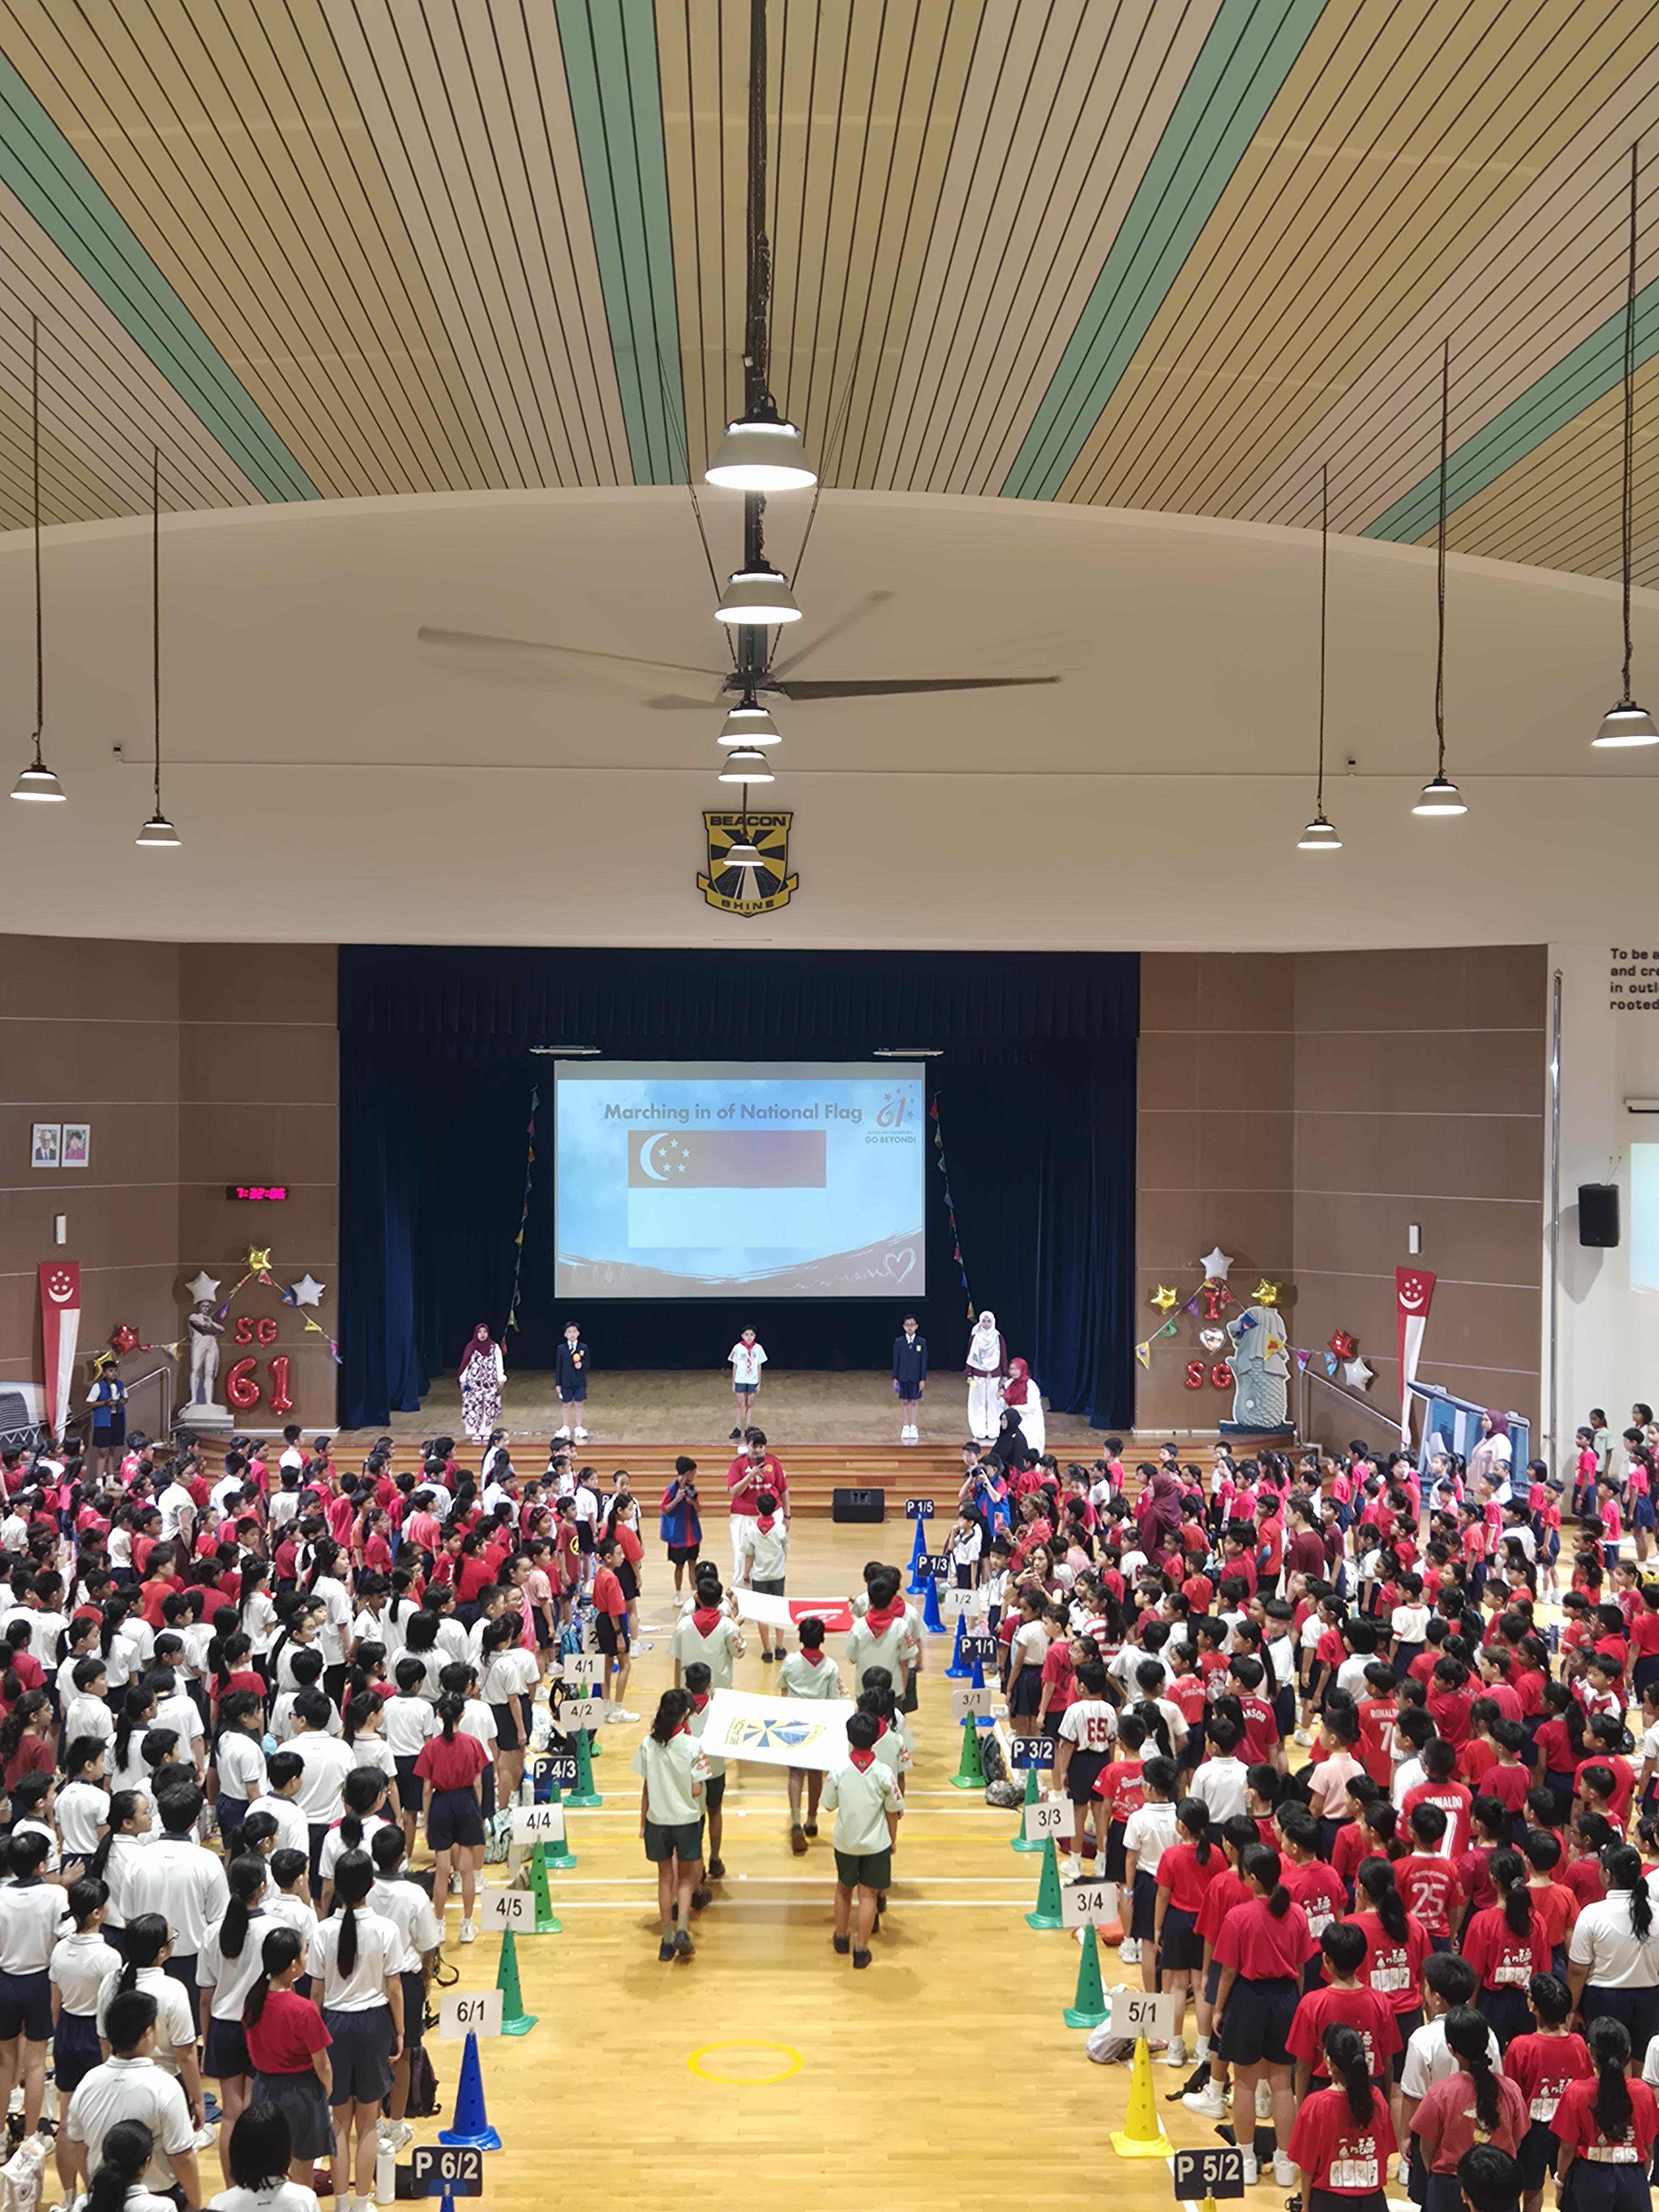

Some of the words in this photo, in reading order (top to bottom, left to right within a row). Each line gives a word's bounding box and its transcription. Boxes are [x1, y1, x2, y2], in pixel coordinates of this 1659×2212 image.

[710, 816, 786, 826] BEACON
[1610, 948, 1627, 959] To
[1632, 949, 1648, 959] be
[1610, 965, 1636, 976] and
[1610, 982, 1623, 993] in
[1610, 999, 1659, 1010] rooted
[604, 1104, 690, 1124] Marching
[695, 1104, 709, 1119] in
[717, 1104, 736, 1119] of
[741, 1104, 819, 1119] National
[825, 1104, 862, 1123] Flag
[877, 1096, 906, 1127] 61
[234, 1317, 276, 1346] SG
[1185, 1360, 1232, 1389] SG
[225, 1357, 293, 1413] 61
[907, 1501, 915, 1512] P
[918, 1501, 933, 1513] 1/5
[919, 1556, 927, 1569] P
[931, 1557, 948, 1571] 1/3
[955, 1594, 972, 1604] 1/2
[962, 1639, 971, 1653] P
[975, 1639, 994, 1653] 1/1
[575, 1660, 593, 1673] 4/1
[962, 1694, 981, 1705] 3/1
[571, 1704, 592, 1718] 4/2
[1380, 1721, 1393, 1751] 7
[1014, 1741, 1025, 1758] P
[1029, 1741, 1053, 1759] 3/2
[535, 1761, 547, 1778] P
[551, 1761, 577, 1779] 4/3
[526, 1812, 551, 1829] 4/4
[1038, 1808, 1061, 1826] 3/3
[496, 1897, 522, 1917] 4/5
[1077, 1892, 1103, 1911] 3/4
[1411, 1882, 1446, 1917] 25
[457, 2000, 485, 2022] 6/1
[1129, 2001, 1156, 2023] 5/1
[416, 2152, 433, 2179] P
[441, 2152, 478, 2179] 6/2
[1178, 2156, 1195, 2183] P
[1203, 2153, 1240, 2183] 5/2
